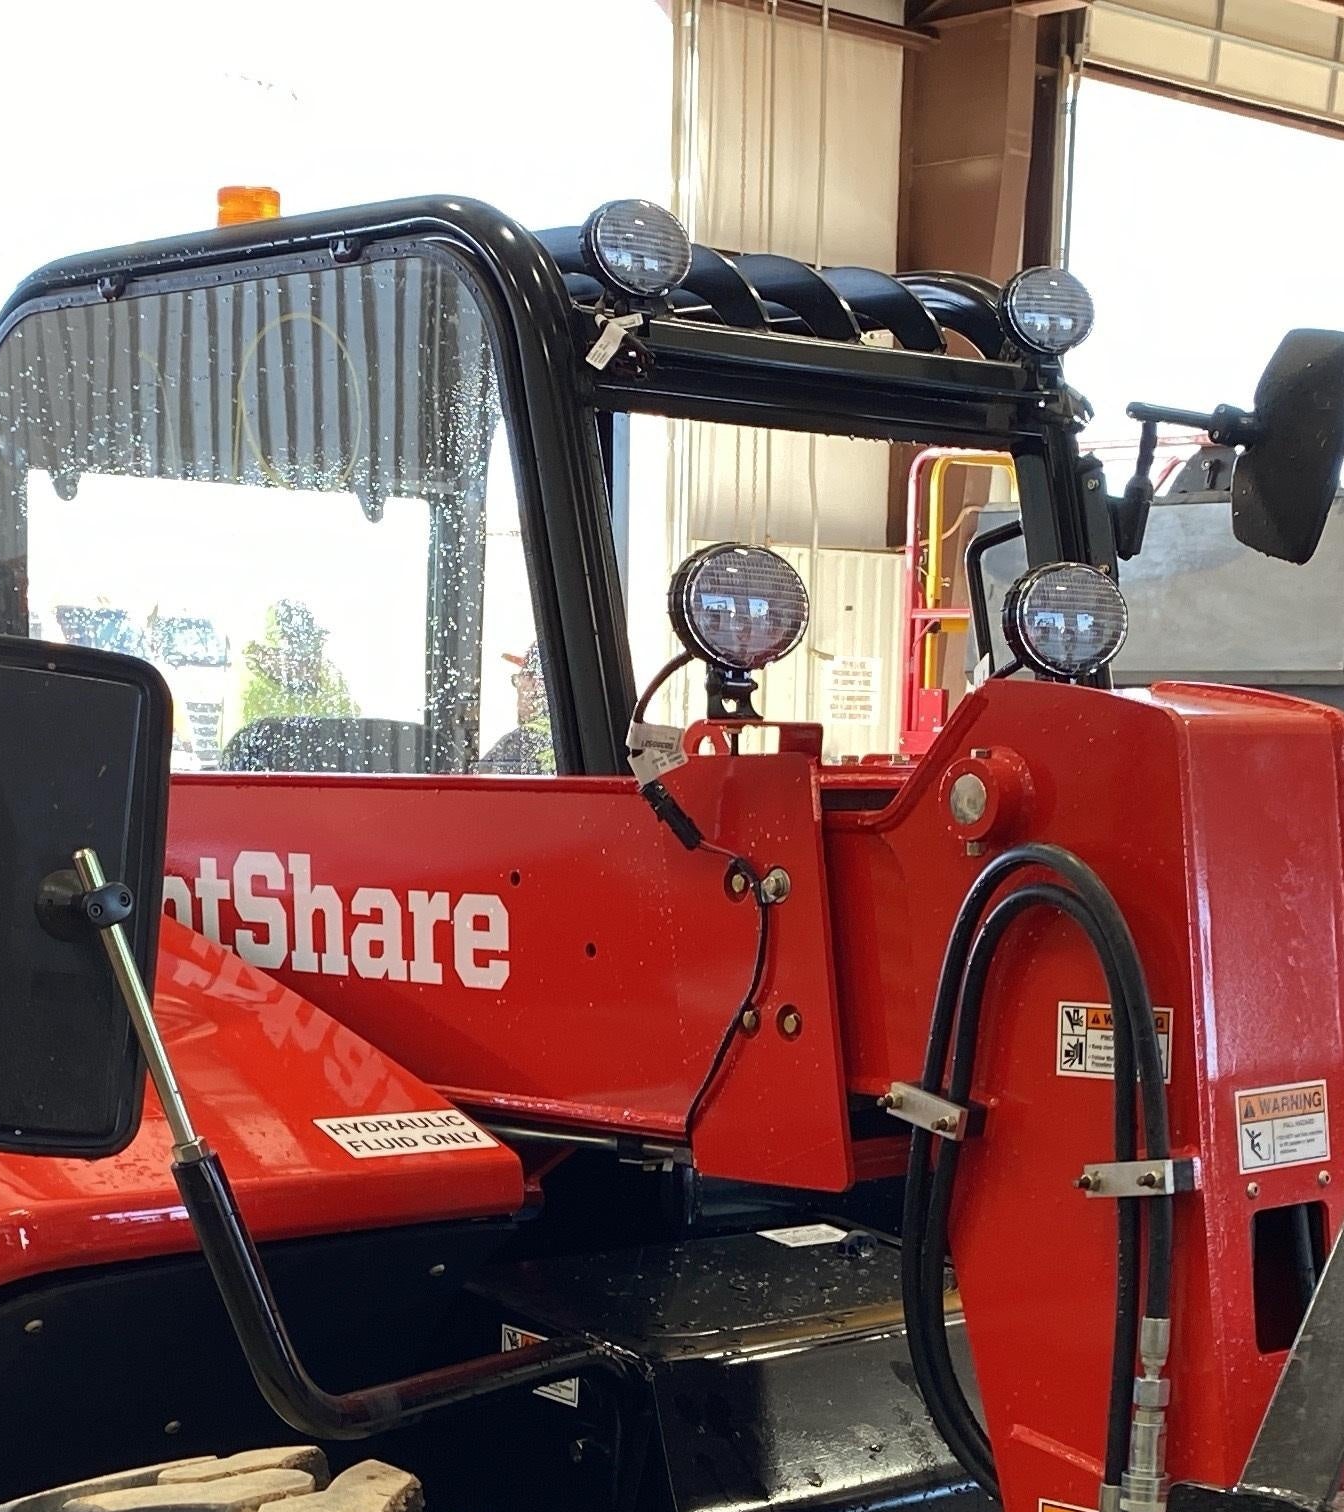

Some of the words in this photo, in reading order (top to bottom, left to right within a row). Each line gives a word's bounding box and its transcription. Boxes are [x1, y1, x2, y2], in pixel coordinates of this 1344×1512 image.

[1258, 1090, 1323, 1115] WARNING
[326, 1114, 466, 1136] HYDRAULIC
[347, 1136, 419, 1152] FLUID
[423, 1130, 484, 1147] ONLY
